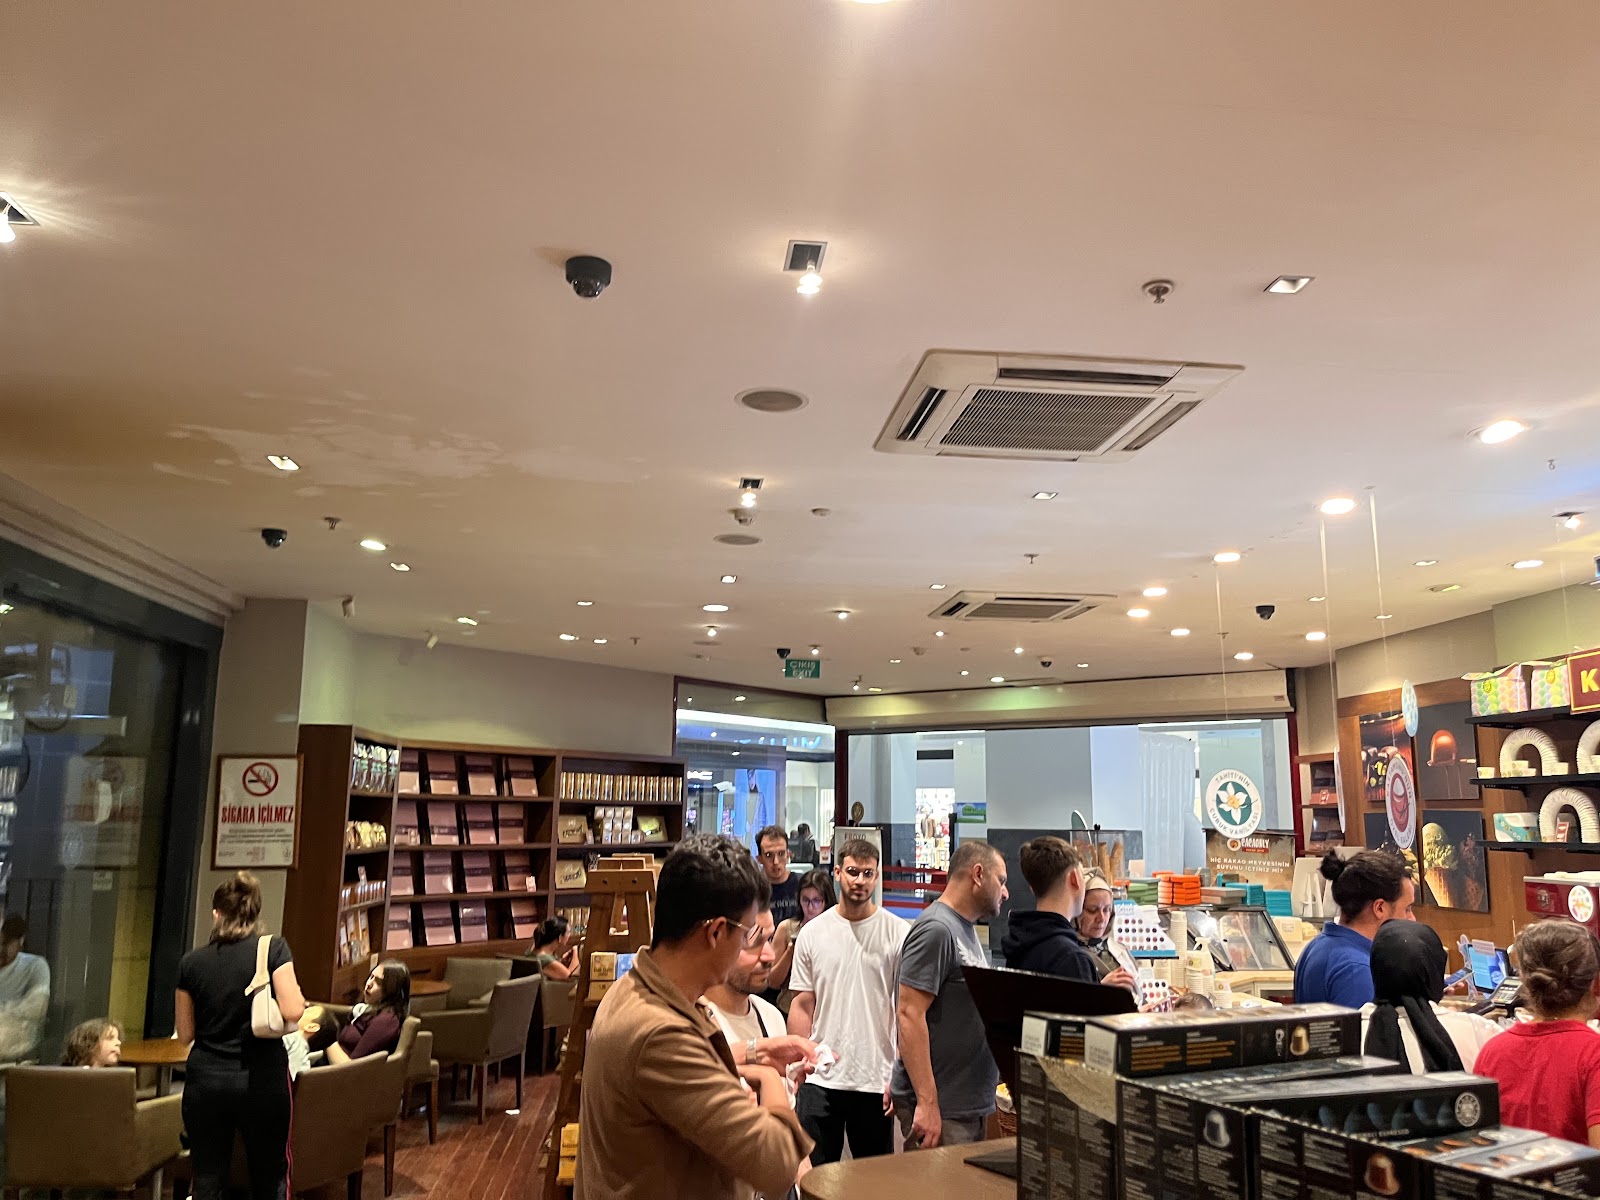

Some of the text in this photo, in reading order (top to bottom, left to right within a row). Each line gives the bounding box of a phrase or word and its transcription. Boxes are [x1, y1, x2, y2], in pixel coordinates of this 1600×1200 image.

[792, 669, 812, 677] EXIT
[222, 803, 294, 827] SİGARA İÇİLMEZ
[1248, 860, 1290, 868] MEYVESİNİN
[1245, 865, 1270, 873] İÇTİNİZ
